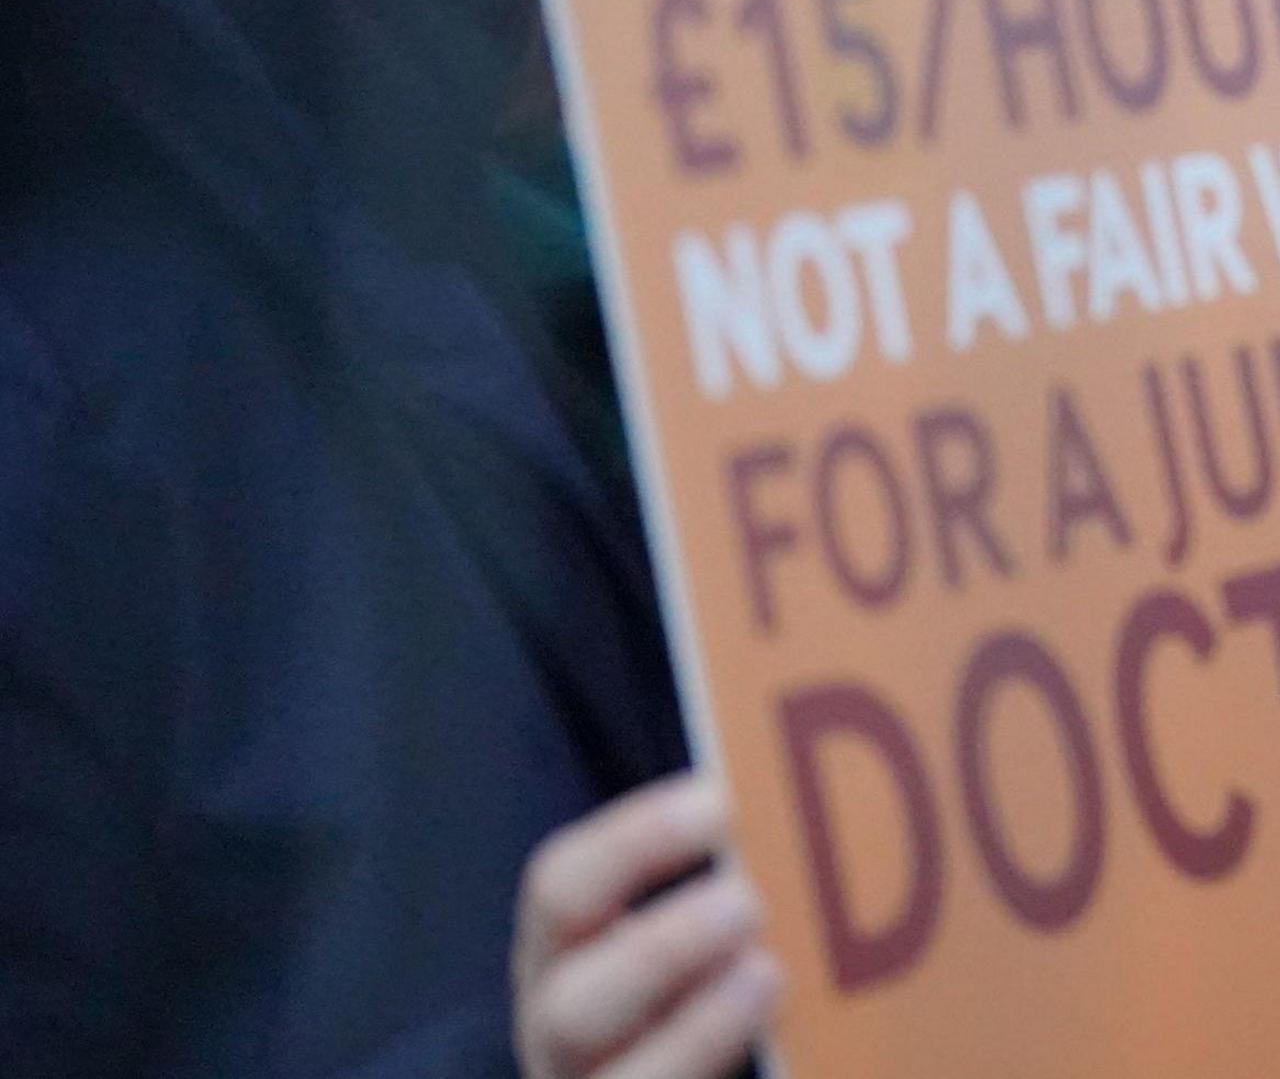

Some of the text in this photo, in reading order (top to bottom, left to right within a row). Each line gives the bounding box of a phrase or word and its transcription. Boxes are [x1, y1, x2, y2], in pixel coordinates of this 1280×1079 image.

[672, 199, 912, 400] NOT
[948, 190, 1030, 351] A
[1024, 151, 1258, 331] FAIR
[726, 401, 1014, 637] FOR
[1044, 387, 1130, 561] A
